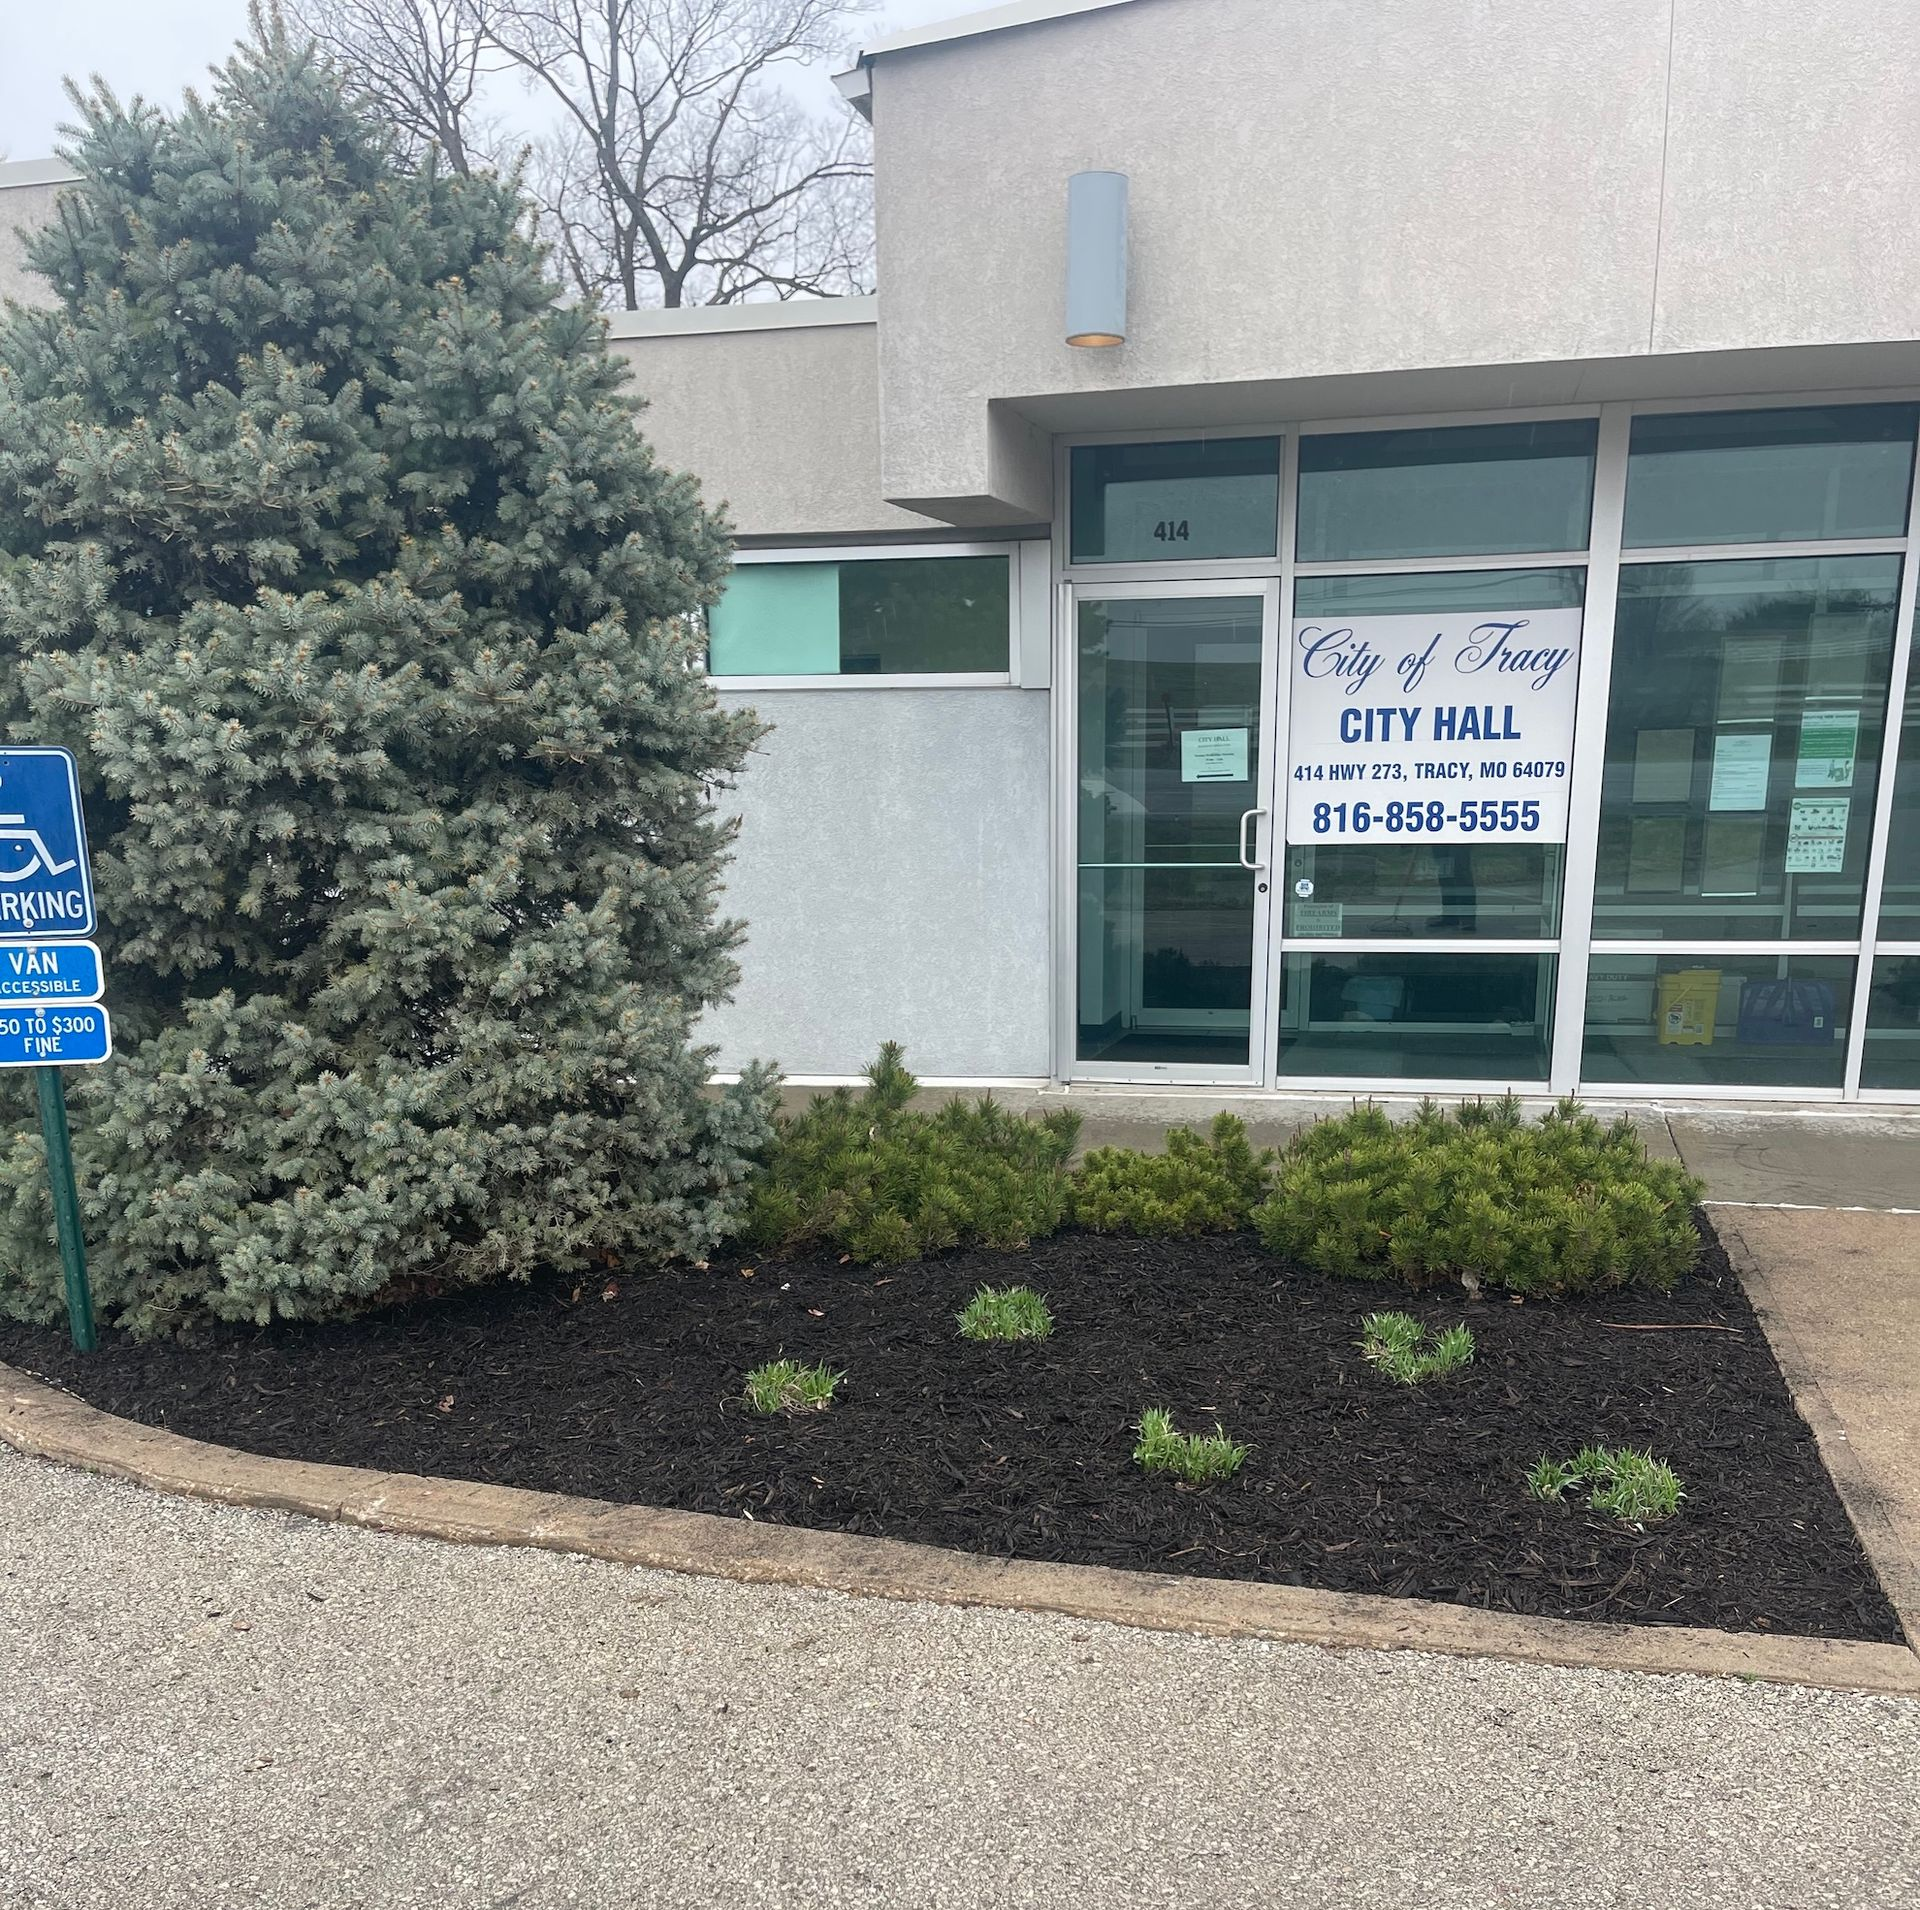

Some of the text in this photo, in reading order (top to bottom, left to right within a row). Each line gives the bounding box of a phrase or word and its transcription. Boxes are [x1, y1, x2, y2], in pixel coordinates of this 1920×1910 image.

[1154, 520, 1190, 541] 414
[1298, 619, 1575, 695] City of Tracy
[1340, 705, 1521, 743] CITY HALL
[1294, 761, 1565, 782] 414 HWY 273, TRACY, MO 64079
[1312, 800, 1540, 834] 816-858-5555
[0, 890, 83, 921] RKING
[8, 952, 59, 975] VAN
[0, 979, 82, 994] CCESSIBLE
[25, 1017, 47, 1034] TO
[52, 1015, 95, 1036] $300
[24, 1037, 63, 1054] FINE
